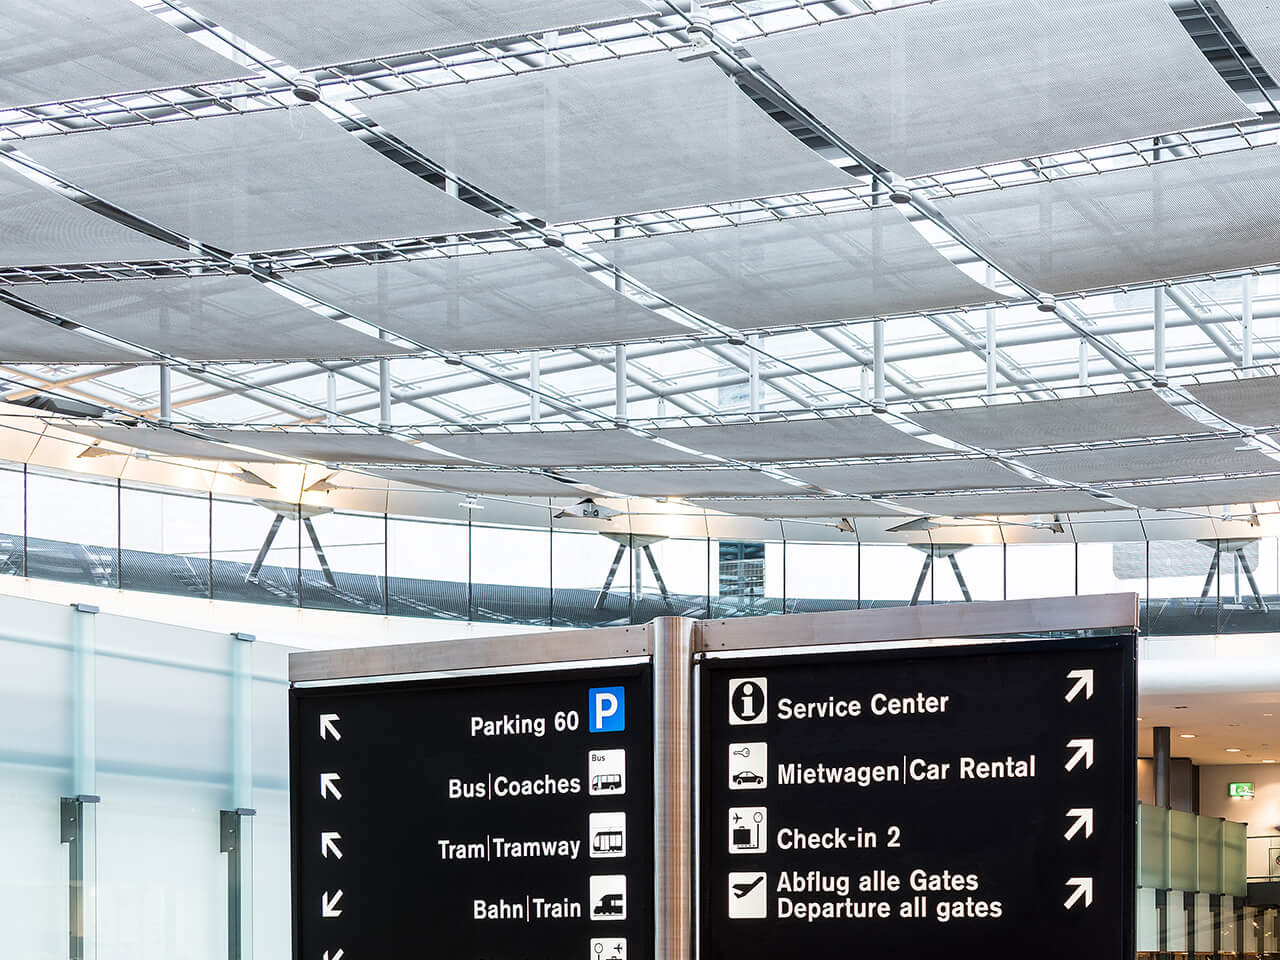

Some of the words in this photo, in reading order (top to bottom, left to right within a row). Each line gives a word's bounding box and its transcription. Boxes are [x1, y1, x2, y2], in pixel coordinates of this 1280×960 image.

[778, 697, 861, 719] Service
[871, 693, 949, 715] Center
[472, 715, 545, 736] Parking
[555, 711, 578, 731] 60
[592, 754, 606, 762] Bus
[961, 755, 1035, 778] Rental
[777, 828, 876, 849] Check-in
[888, 826, 900, 847] 2
[777, 871, 849, 896] Abflug
[859, 870, 900, 891] alle
[910, 870, 978, 891] Gates
[778, 898, 890, 922] Departure
[900, 897, 926, 917] all
[937, 899, 1002, 922] gates
